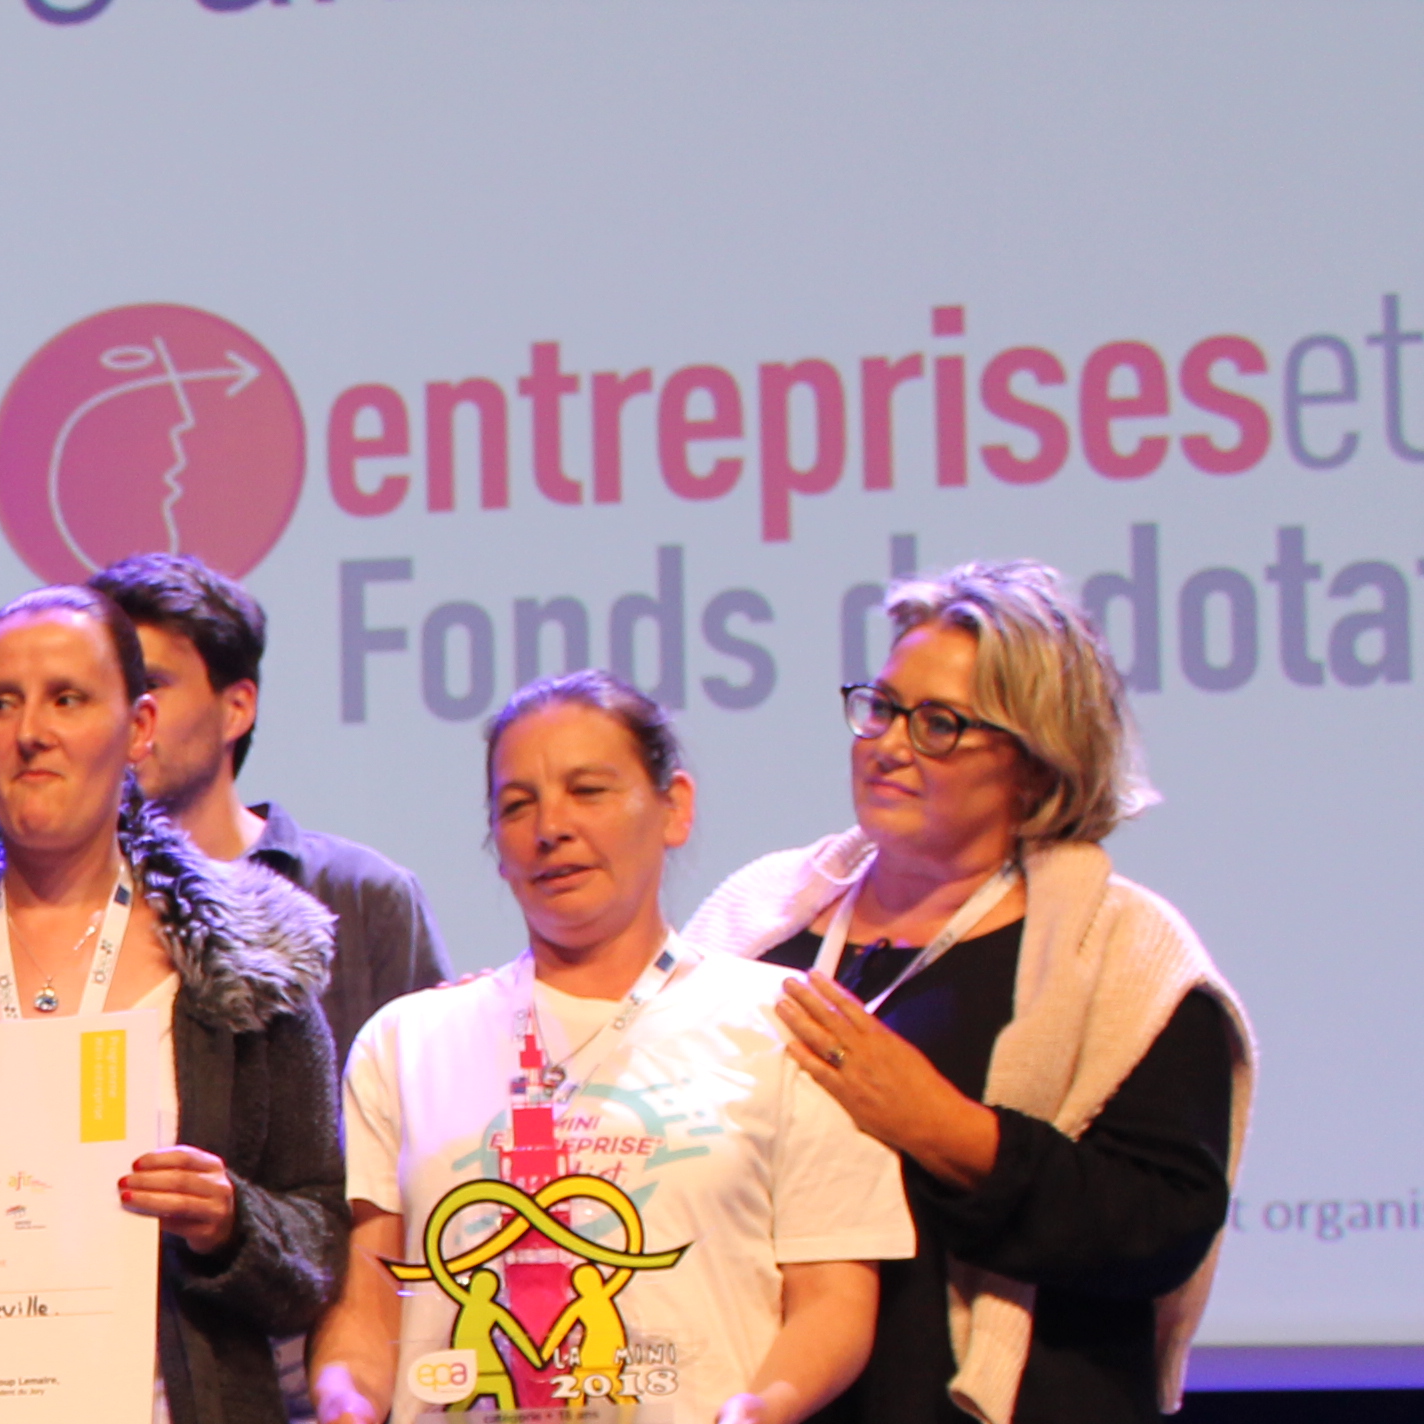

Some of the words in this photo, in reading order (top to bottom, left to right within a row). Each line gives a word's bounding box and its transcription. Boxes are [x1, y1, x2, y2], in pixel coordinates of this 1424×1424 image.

[338, 544, 779, 725] Fonds
[553, 1346, 581, 1369] LA
[614, 1343, 676, 1365] MINI
[416, 1362, 468, 1392] epa
[550, 1369, 679, 1400] 2018
